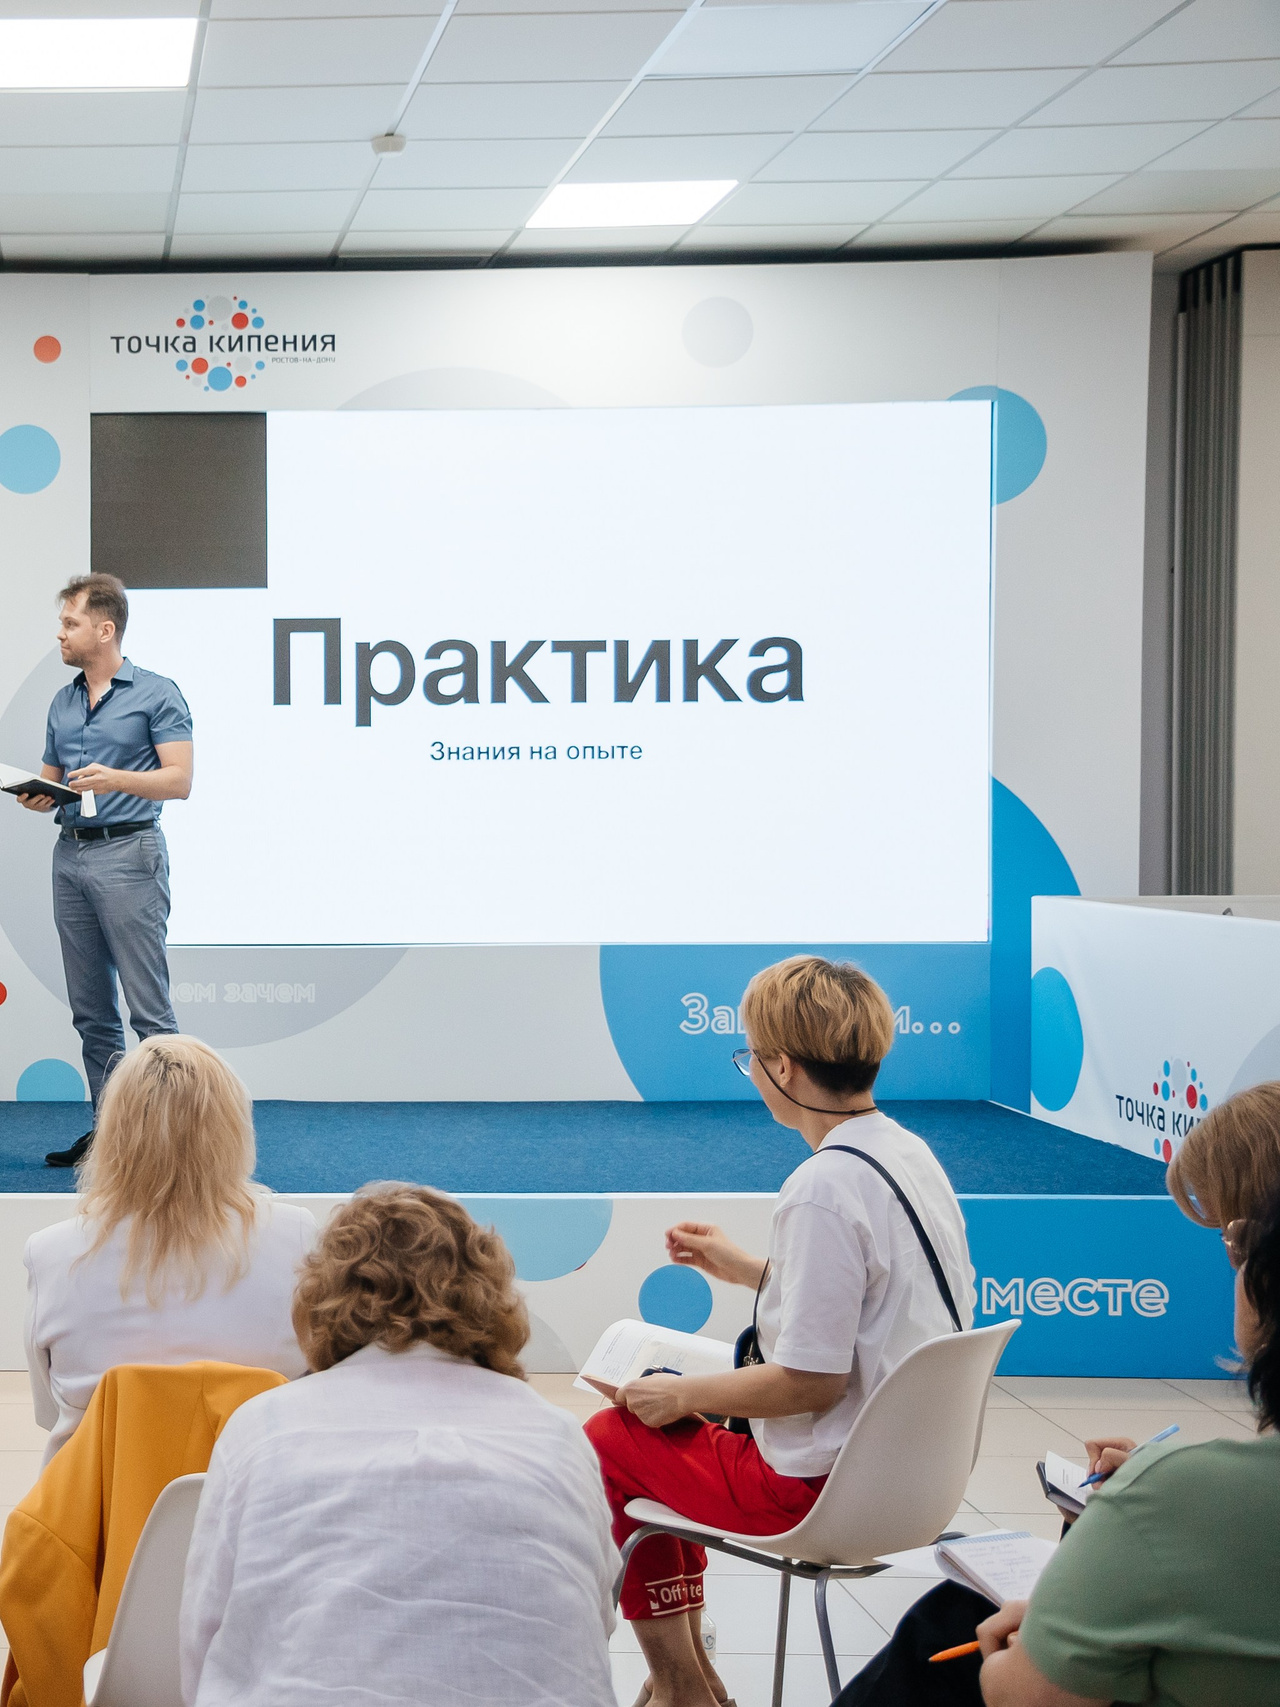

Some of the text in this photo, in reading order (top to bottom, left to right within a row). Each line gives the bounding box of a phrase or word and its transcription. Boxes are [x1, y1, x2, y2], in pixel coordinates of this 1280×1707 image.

[110, 334, 336, 354] точка кипения
[272, 617, 805, 728] Практика
[429, 741, 643, 761] Знания на опыте
[170, 982, 316, 1004] ем зачем
[1115, 1094, 1201, 1138] точка ки
[970, 1263, 1169, 1318] месте
